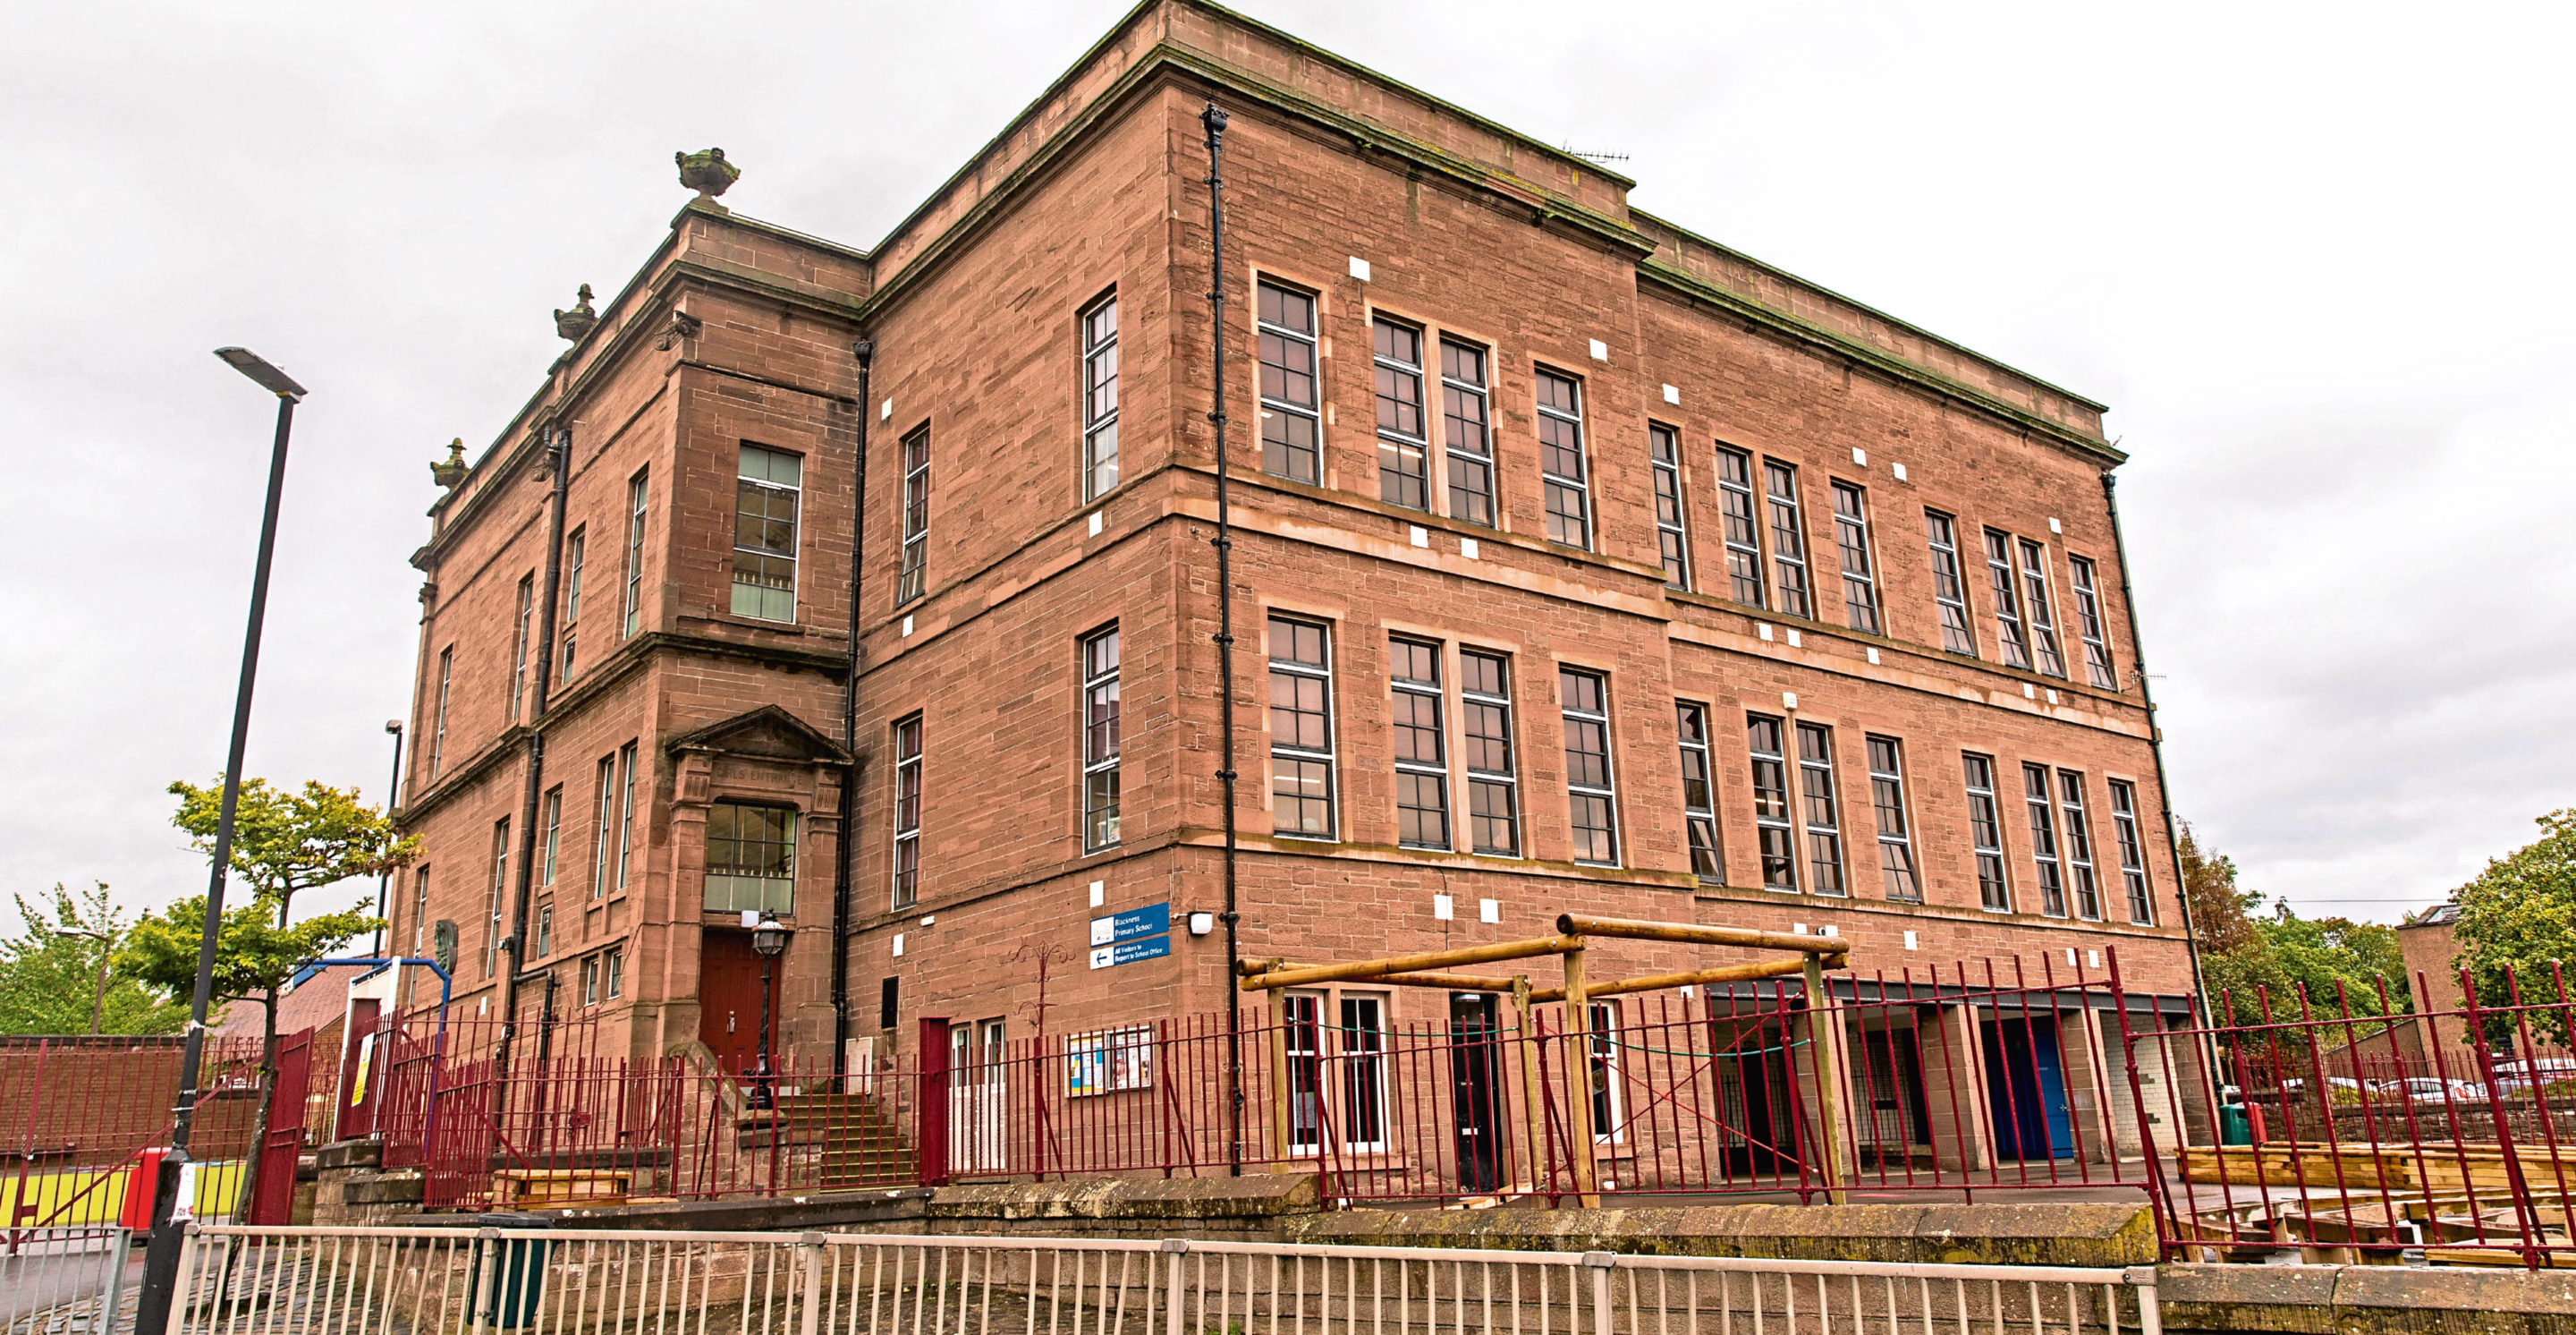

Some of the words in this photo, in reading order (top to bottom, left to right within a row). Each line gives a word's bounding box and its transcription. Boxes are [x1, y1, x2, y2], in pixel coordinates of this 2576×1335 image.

[1114, 915, 1140, 926] Blackness
[1114, 927, 1135, 937] Primary
[1135, 923, 1153, 932] School
[1114, 954, 1130, 963] Report
[1135, 950, 1149, 958] School
